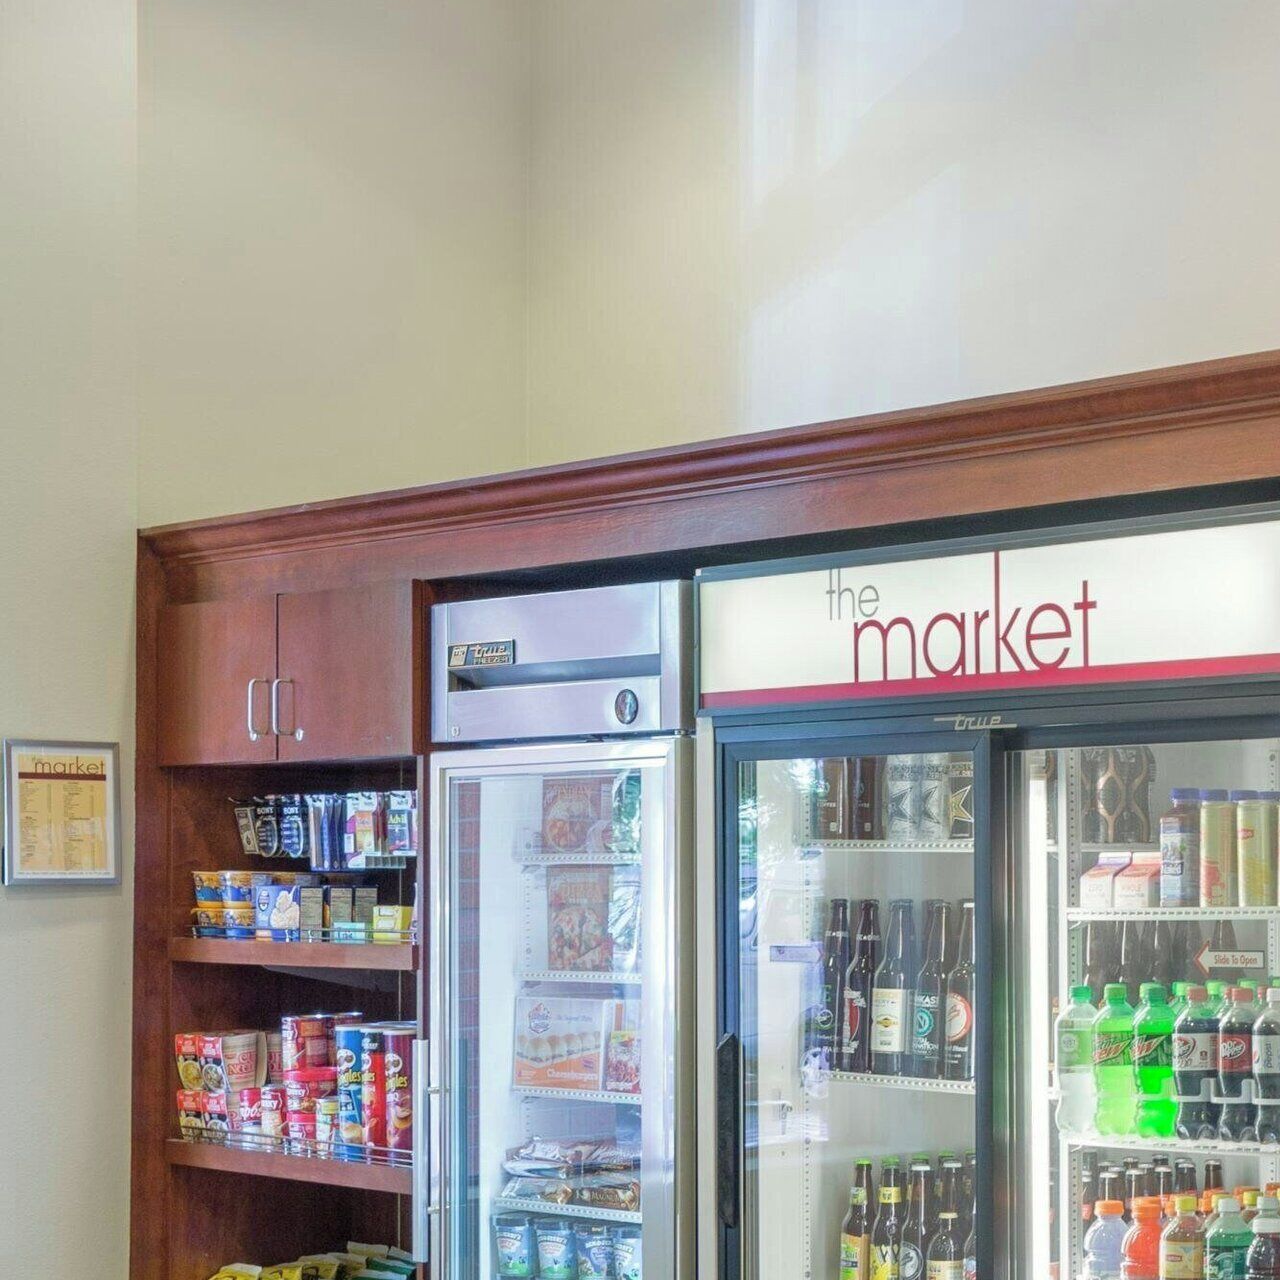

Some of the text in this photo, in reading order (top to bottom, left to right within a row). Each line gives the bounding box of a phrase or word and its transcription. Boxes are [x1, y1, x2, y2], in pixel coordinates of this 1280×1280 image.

[826, 568, 880, 620] the
[854, 550, 1097, 682] market
[470, 645, 506, 658] true
[934, 715, 1018, 731] true
[34, 756, 105, 774] market
[1214, 954, 1230, 964] Slide
[1240, 954, 1258, 966] Open
